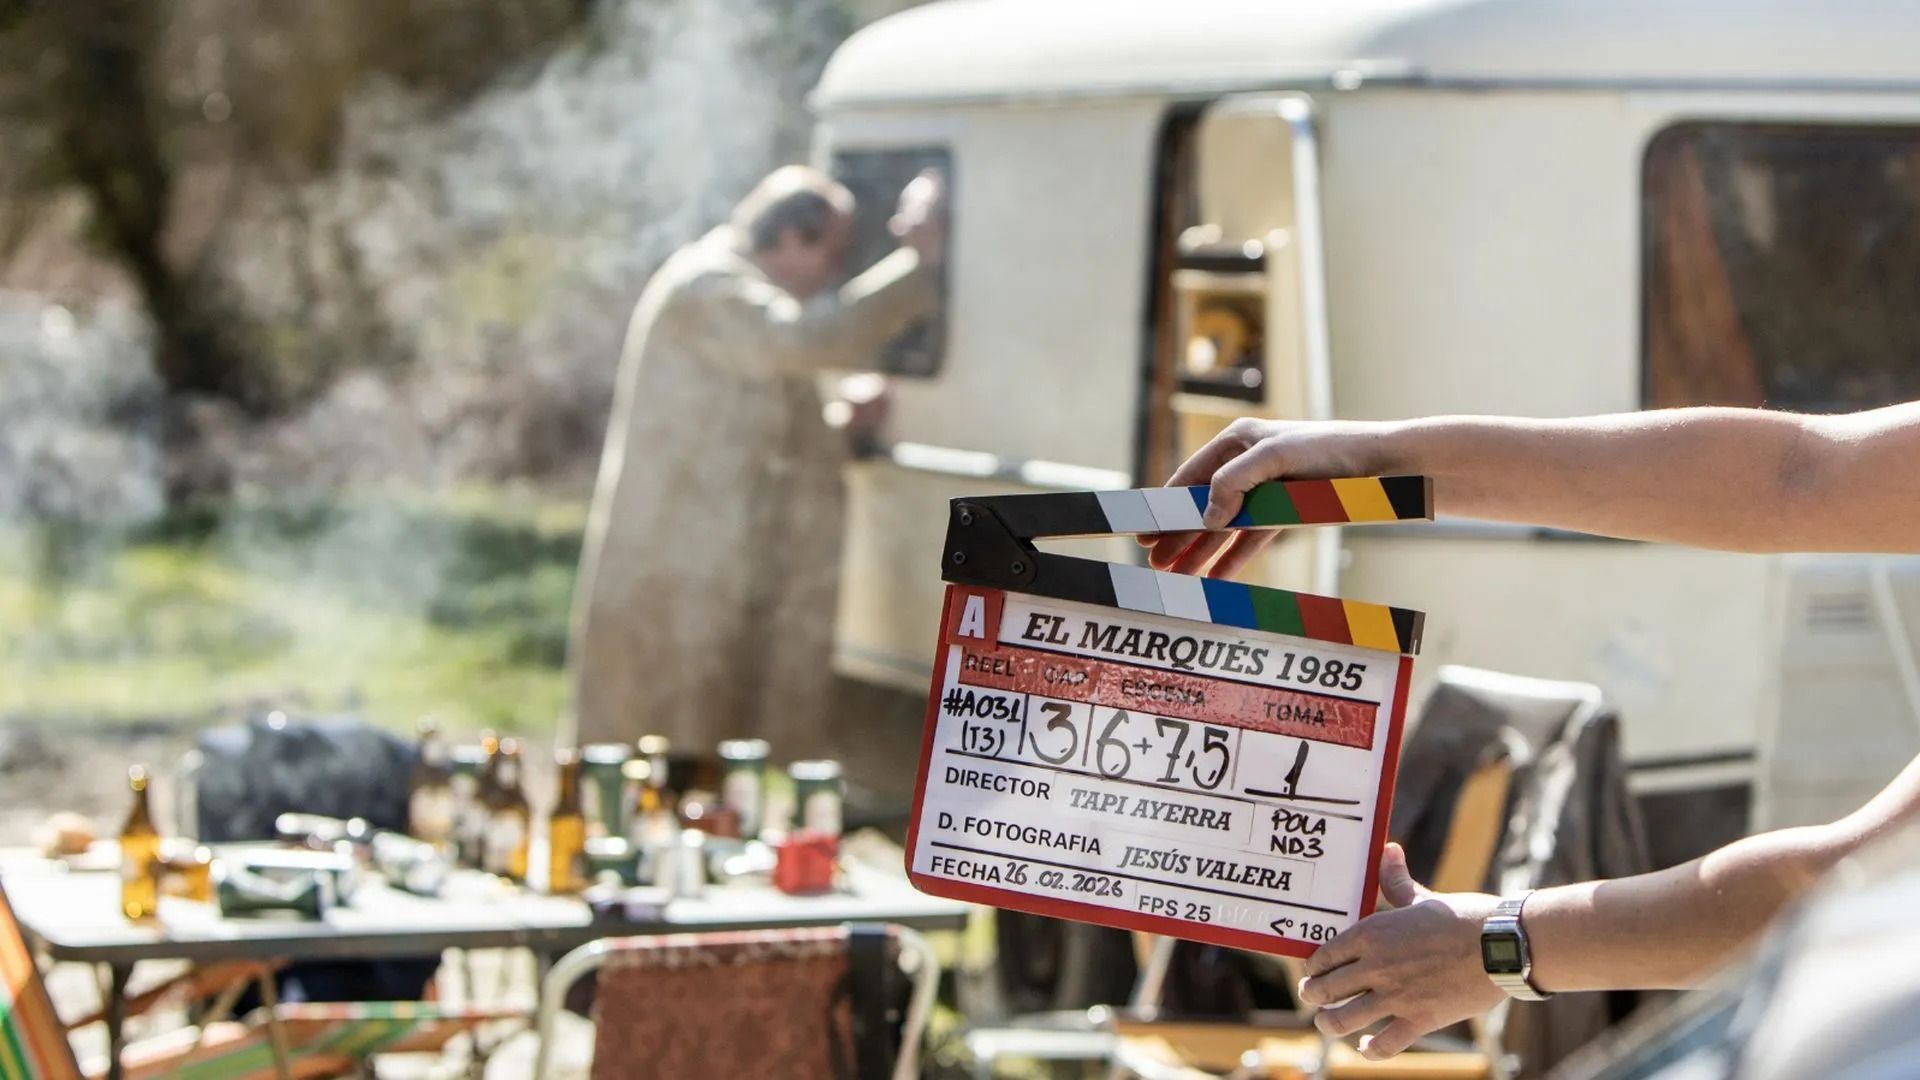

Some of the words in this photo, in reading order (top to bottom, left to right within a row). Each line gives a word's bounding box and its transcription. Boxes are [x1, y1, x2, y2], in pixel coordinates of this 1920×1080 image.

[957, 594, 986, 640] A
[1021, 612, 1070, 648] EL
[1077, 619, 1269, 676] MARQUÉS
[1276, 653, 1367, 692] 1985
[943, 688, 1021, 723] #A031
[965, 653, 1015, 677] REEL
[1263, 701, 1326, 728] TOMA
[1029, 702, 1078, 765] 3
[945, 766, 1051, 800] DIRECTOR
[1069, 788, 1128, 815] TAPI
[1130, 798, 1232, 831] AYERRA
[1271, 808, 1326, 835] POLA
[938, 811, 957, 832] D.
[963, 816, 1102, 855] FOTOGRAFIA
[1116, 845, 1191, 875] JESÚS
[1196, 857, 1293, 891] VALERA
[1270, 834, 1324, 858] ND3
[930, 855, 1001, 883] FECHA
[1138, 895, 1178, 917] FPS
[1184, 903, 1212, 922] 25
